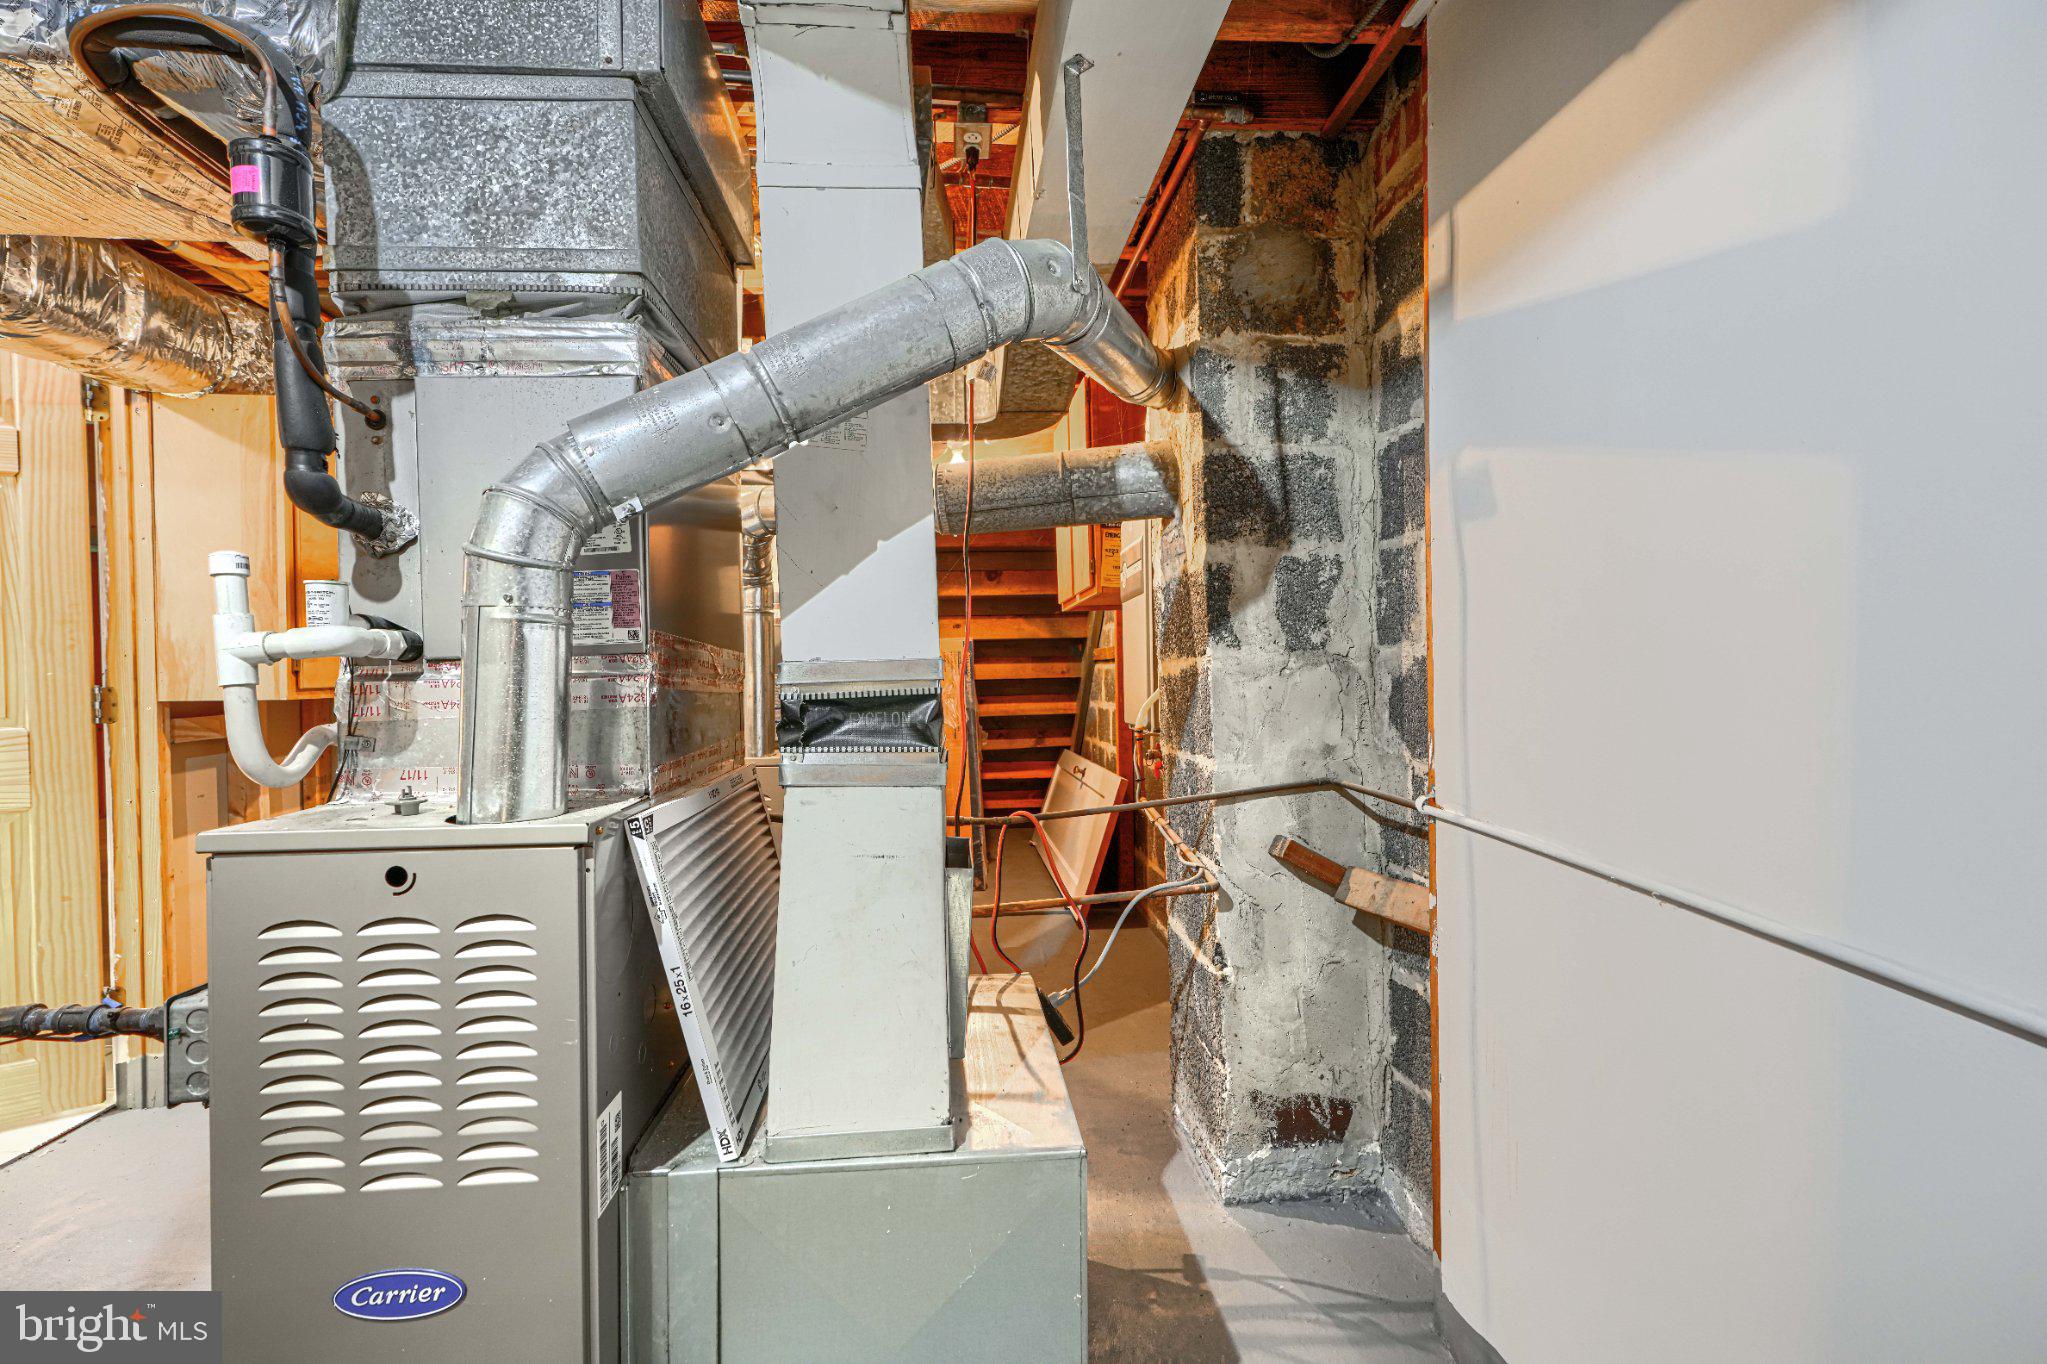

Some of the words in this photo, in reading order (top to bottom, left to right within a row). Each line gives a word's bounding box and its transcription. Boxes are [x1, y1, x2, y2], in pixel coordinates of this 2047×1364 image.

[400, 769, 428, 781] 11/17
[717, 1128, 733, 1156] HDX
[351, 1284, 446, 1307] Carrier
